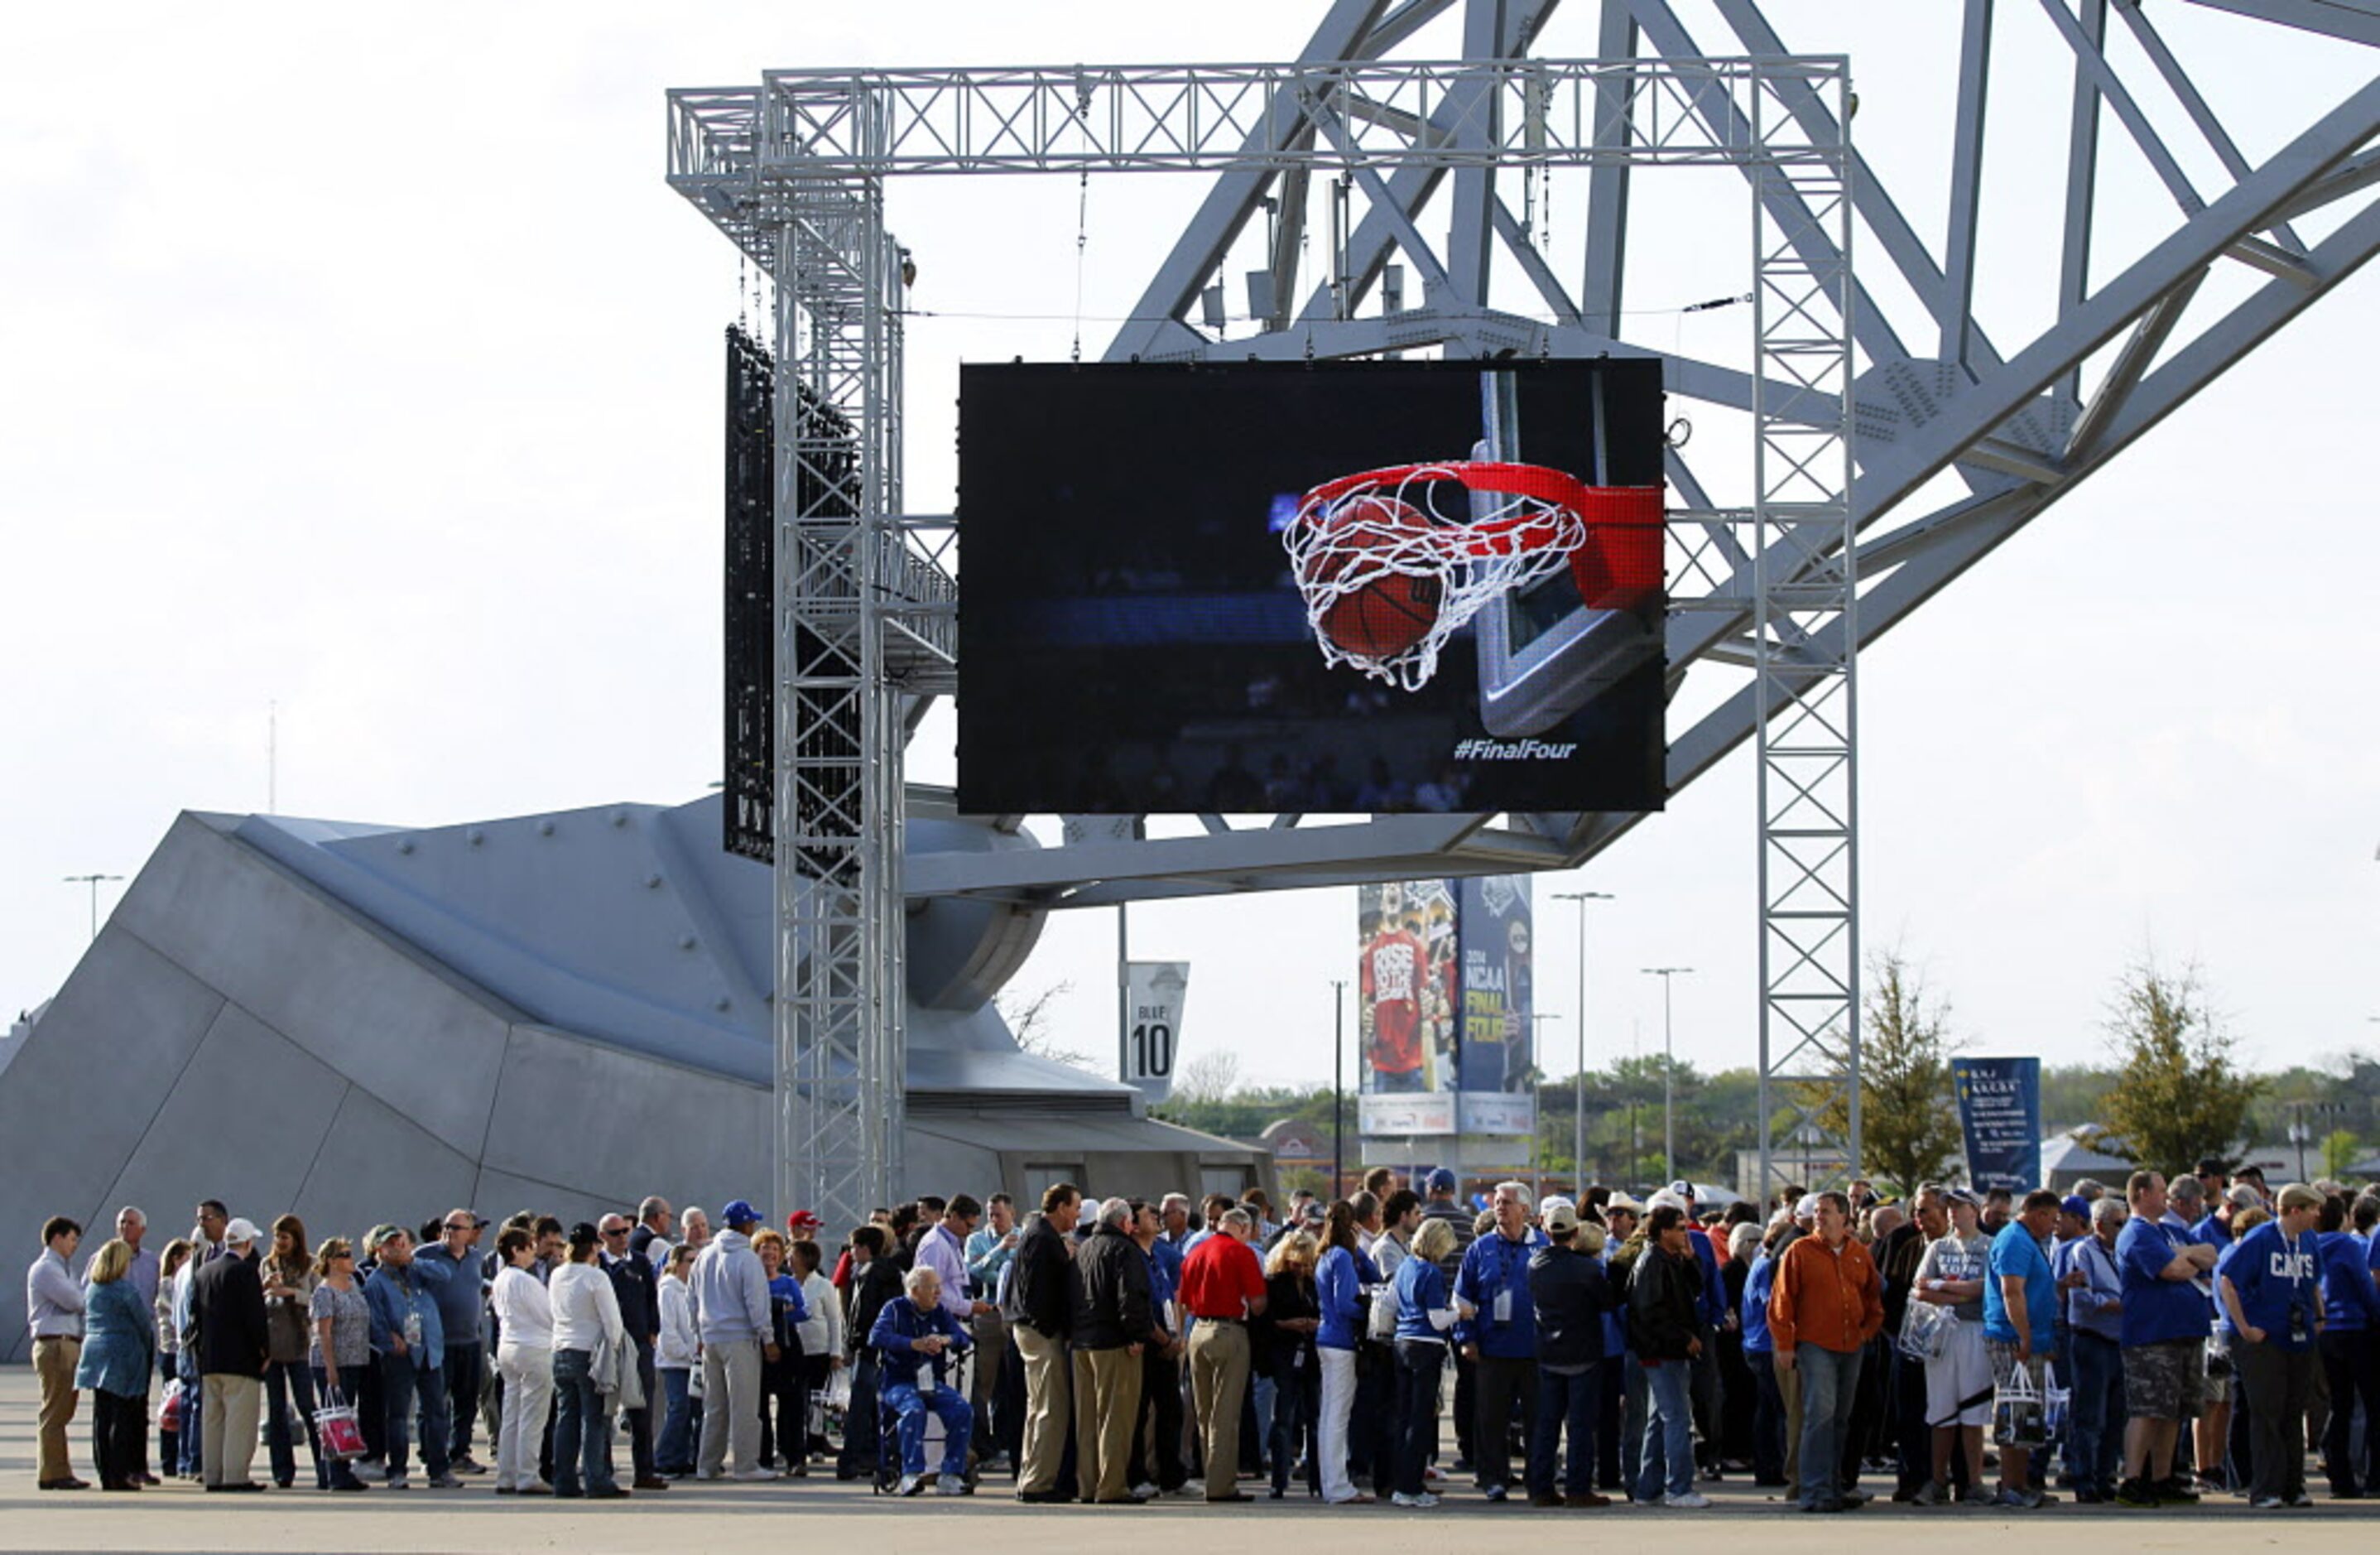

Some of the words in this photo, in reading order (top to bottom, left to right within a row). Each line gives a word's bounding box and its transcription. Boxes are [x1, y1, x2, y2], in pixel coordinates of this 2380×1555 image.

[1454, 738, 1576, 759] #FinalFour
[1466, 966, 1504, 991] NCAA
[1465, 989, 1503, 1015] FINAL
[1465, 1016, 1504, 1042] FOUR
[1132, 1024, 1170, 1076] 10
[2270, 1251, 2314, 1278] CATS
